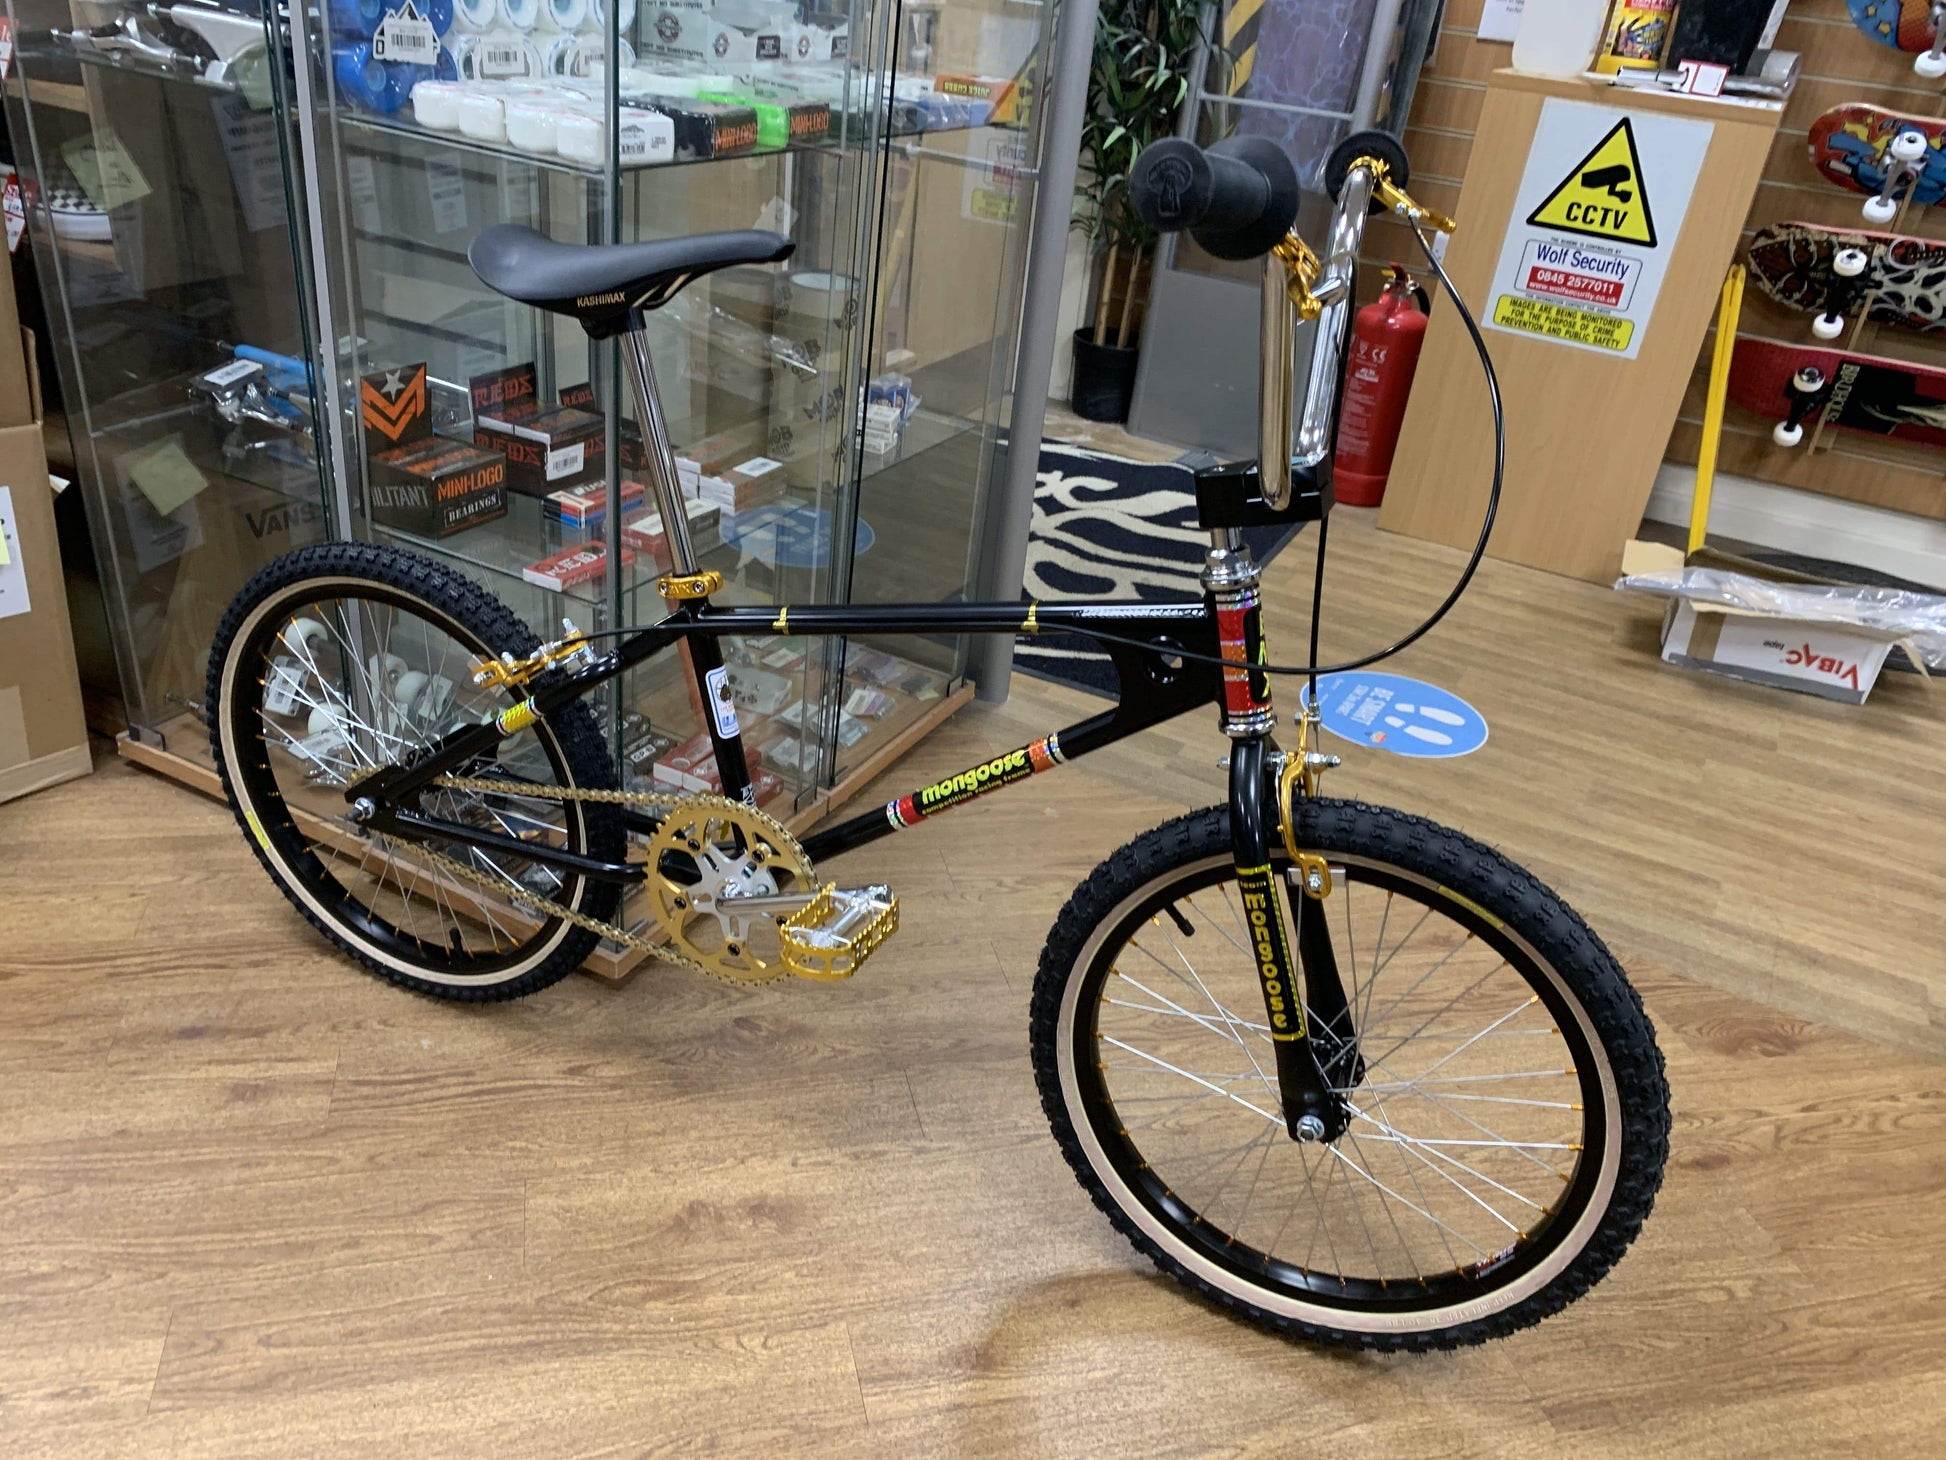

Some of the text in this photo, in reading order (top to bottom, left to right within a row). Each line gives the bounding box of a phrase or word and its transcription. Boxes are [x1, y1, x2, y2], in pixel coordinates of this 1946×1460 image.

[1566, 202, 1628, 230] CCTV
[1536, 243, 1630, 280] Wolf Security
[1529, 281, 1617, 305] www.wolfsecurity.co.uk
[1536, 269, 1615, 294] 0845 2577011
[577, 291, 626, 308] KASHIMAX
[1509, 300, 1623, 329] IMAGES ARE BEING MONITORED
[1501, 316, 1621, 348] PREVENTION AND PUBLIC SAFETY
[1511, 308, 1615, 337] FOR THE PURPOSE OF CRIME
[437, 463, 504, 503] MINI-LOGO
[449, 495, 498, 522] BEARINGS
[1785, 643, 1859, 691] VIBAC
[921, 748, 1026, 805] mongoose
[921, 767, 1031, 816] competition racing frame
[1244, 892, 1289, 1029] mongoose
